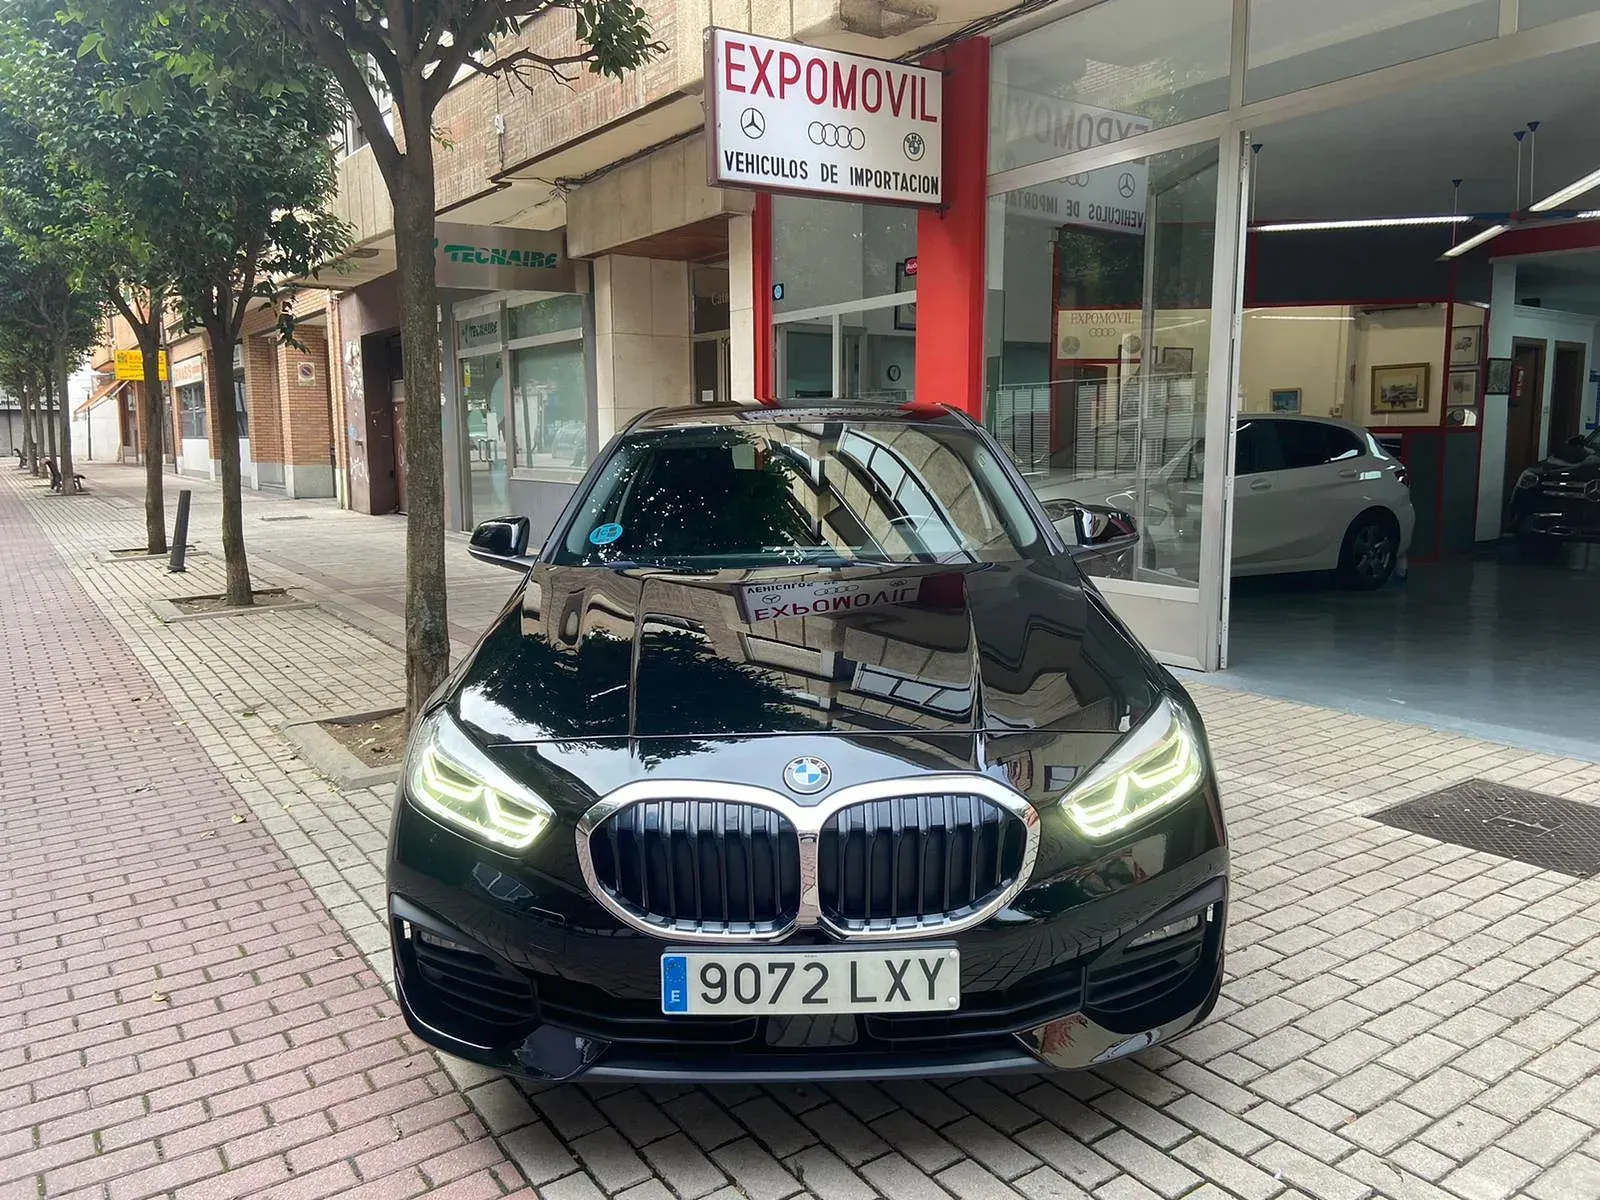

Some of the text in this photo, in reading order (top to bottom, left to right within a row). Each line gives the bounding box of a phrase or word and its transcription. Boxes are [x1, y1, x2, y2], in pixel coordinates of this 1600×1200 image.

[725, 41, 937, 122] EXPOMOVIL
[724, 150, 939, 195] VEHICULOS DE IMPORTACION
[444, 244, 557, 268] TECNAIRE
[470, 321, 497, 337] TECNAIRE
[1071, 311, 1134, 324] EXPOMOVIL
[700, 957, 945, 1004] 9072 LXY
[671, 990, 680, 1003] E
